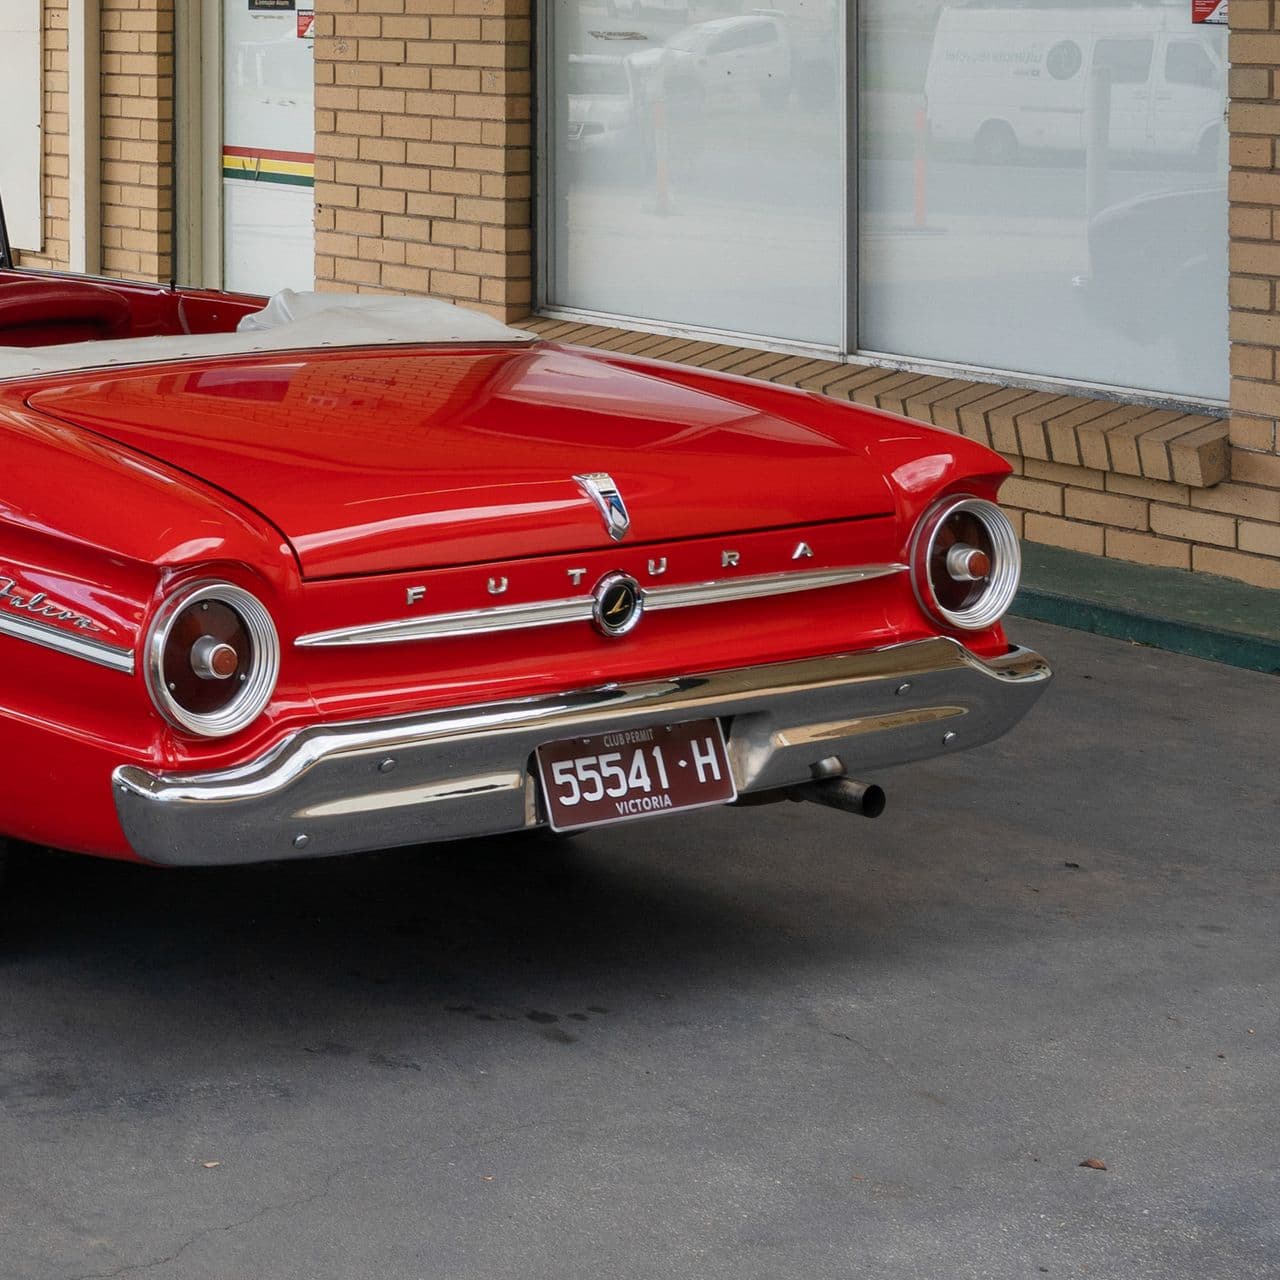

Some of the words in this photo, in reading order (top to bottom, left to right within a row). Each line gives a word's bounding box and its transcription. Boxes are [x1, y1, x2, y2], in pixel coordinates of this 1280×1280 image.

[406, 540, 815, 605] FUTURA
[603, 732, 625, 748] CLUB
[625, 728, 655, 745] PERMIT
[615, 794, 673, 816] VICTORIA
